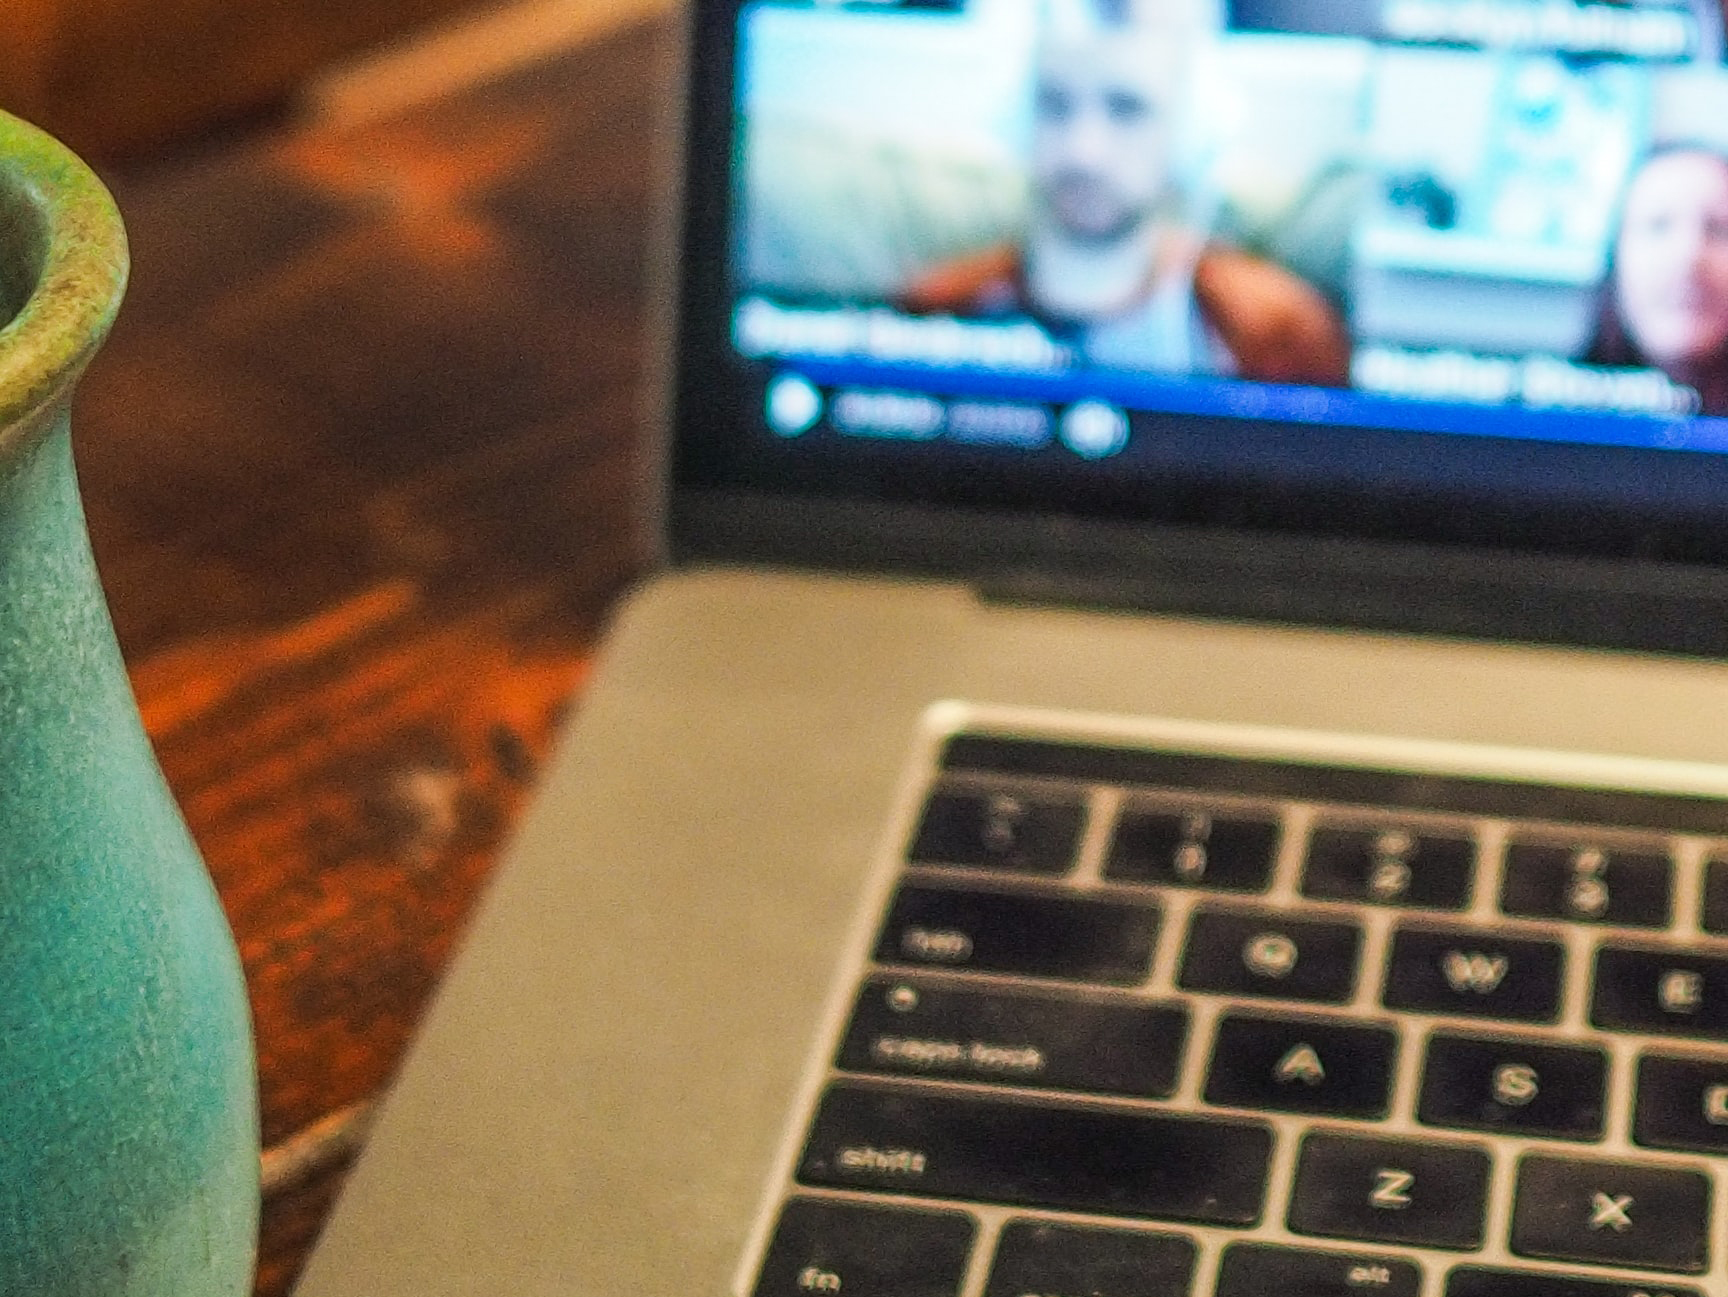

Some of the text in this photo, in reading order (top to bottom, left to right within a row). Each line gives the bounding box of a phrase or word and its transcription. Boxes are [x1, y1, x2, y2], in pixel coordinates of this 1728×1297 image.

[1444, 951, 1507, 992] W
[1659, 970, 1702, 1010] E
[876, 1038, 1044, 1072] caps lock
[1277, 1045, 1324, 1085] A
[1494, 1065, 1538, 1104] S
[841, 1148, 925, 1173] shift
[1371, 1168, 1413, 1207] Z
[1590, 1191, 1634, 1231] X
[799, 1267, 842, 1293] fn
[1348, 1265, 1390, 1286] alt
